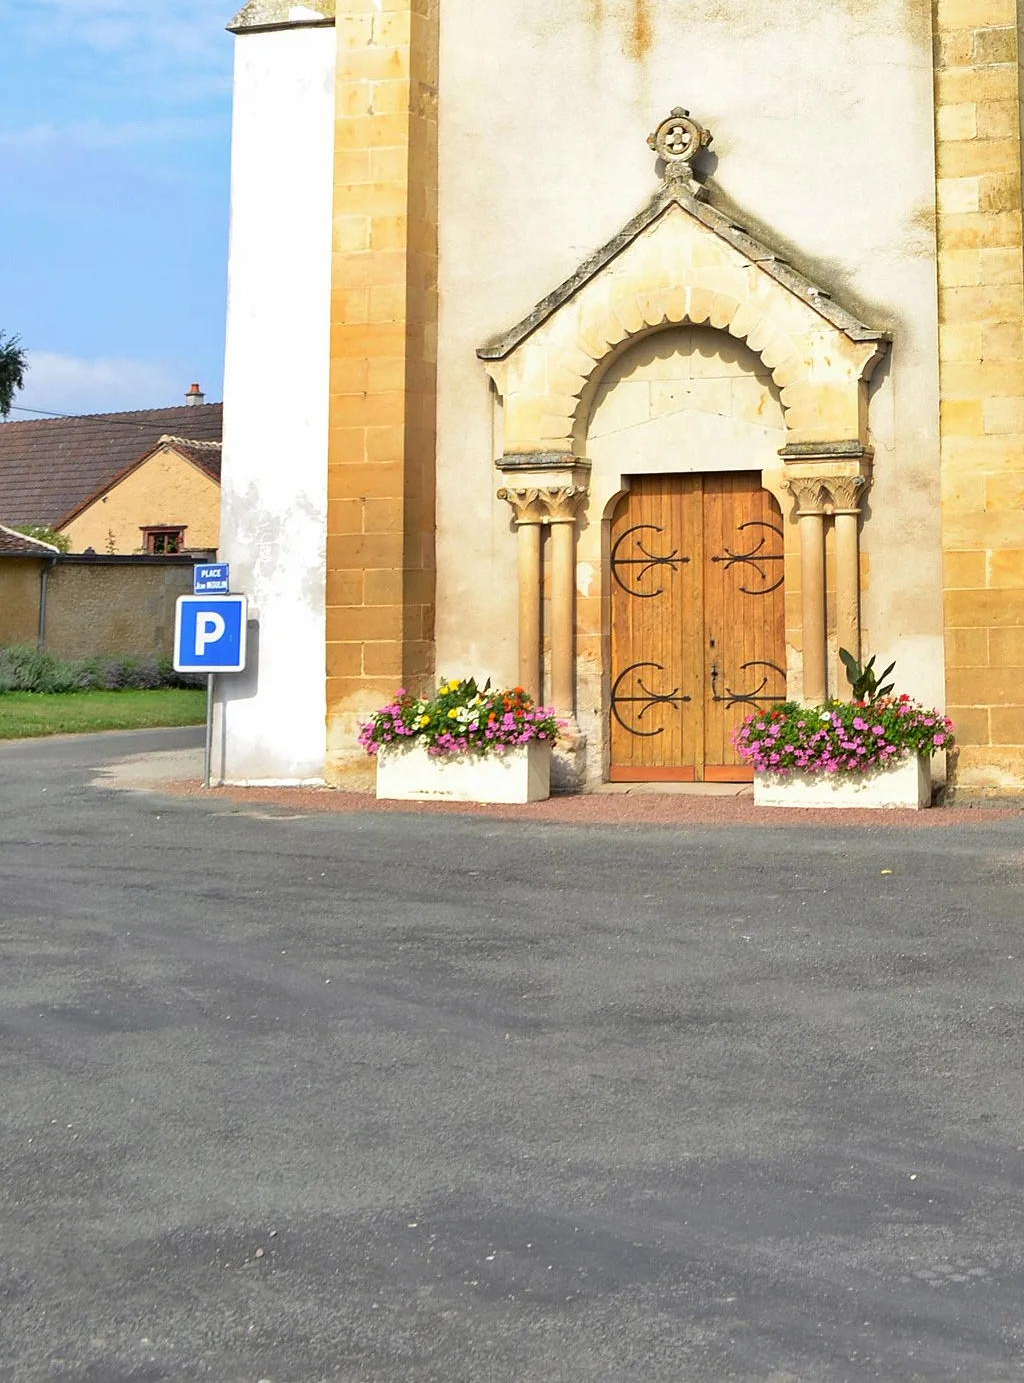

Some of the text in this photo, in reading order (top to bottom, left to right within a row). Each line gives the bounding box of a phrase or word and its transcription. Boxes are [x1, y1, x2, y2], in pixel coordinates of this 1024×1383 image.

[201, 569, 222, 578] PLACE
[206, 581, 227, 589] MOULIN
[194, 611, 226, 656] P
